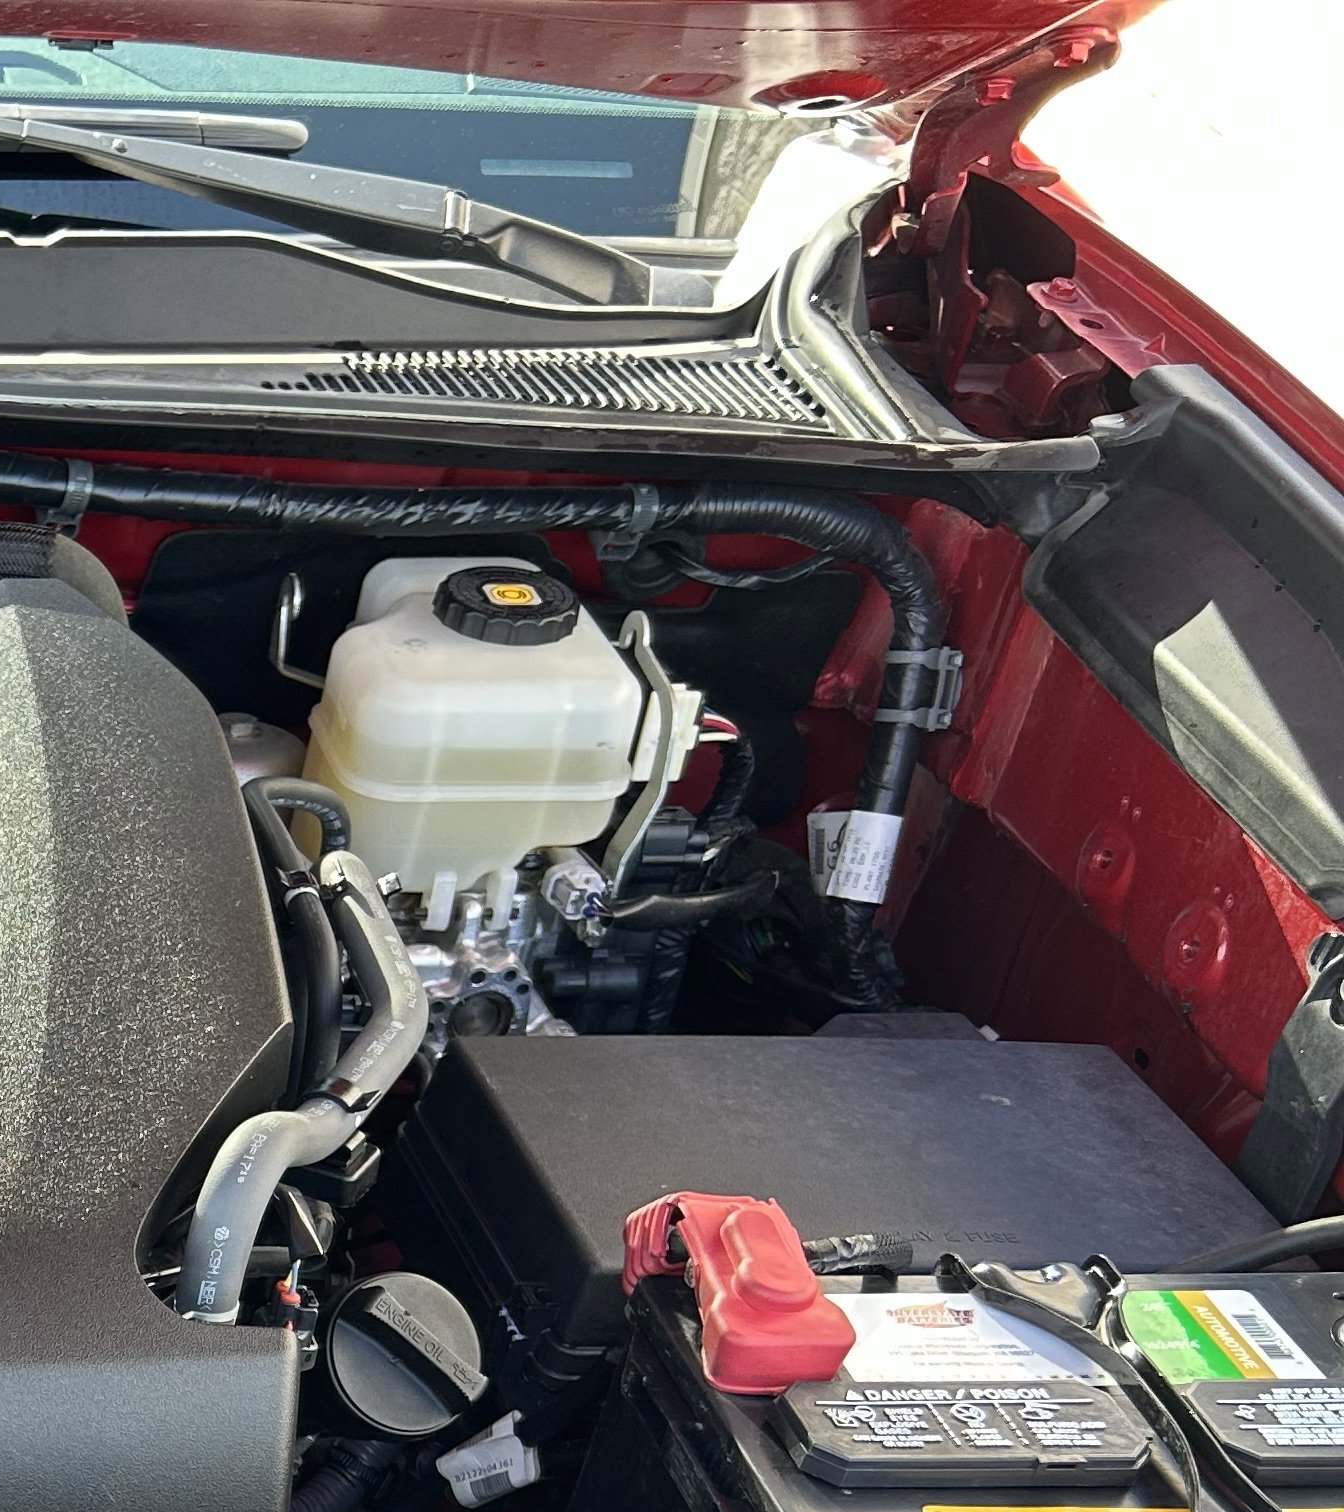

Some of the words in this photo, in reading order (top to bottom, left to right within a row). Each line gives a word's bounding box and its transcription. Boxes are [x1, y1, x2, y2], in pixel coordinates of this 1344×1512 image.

[374, 1298, 425, 1346] ENGINE
[423, 1341, 445, 1365] OIL
[1192, 1304, 1260, 1371] AUTOMOTIVE
[863, 1389, 953, 1400] DANGER
[969, 1388, 1050, 1400] POISON
